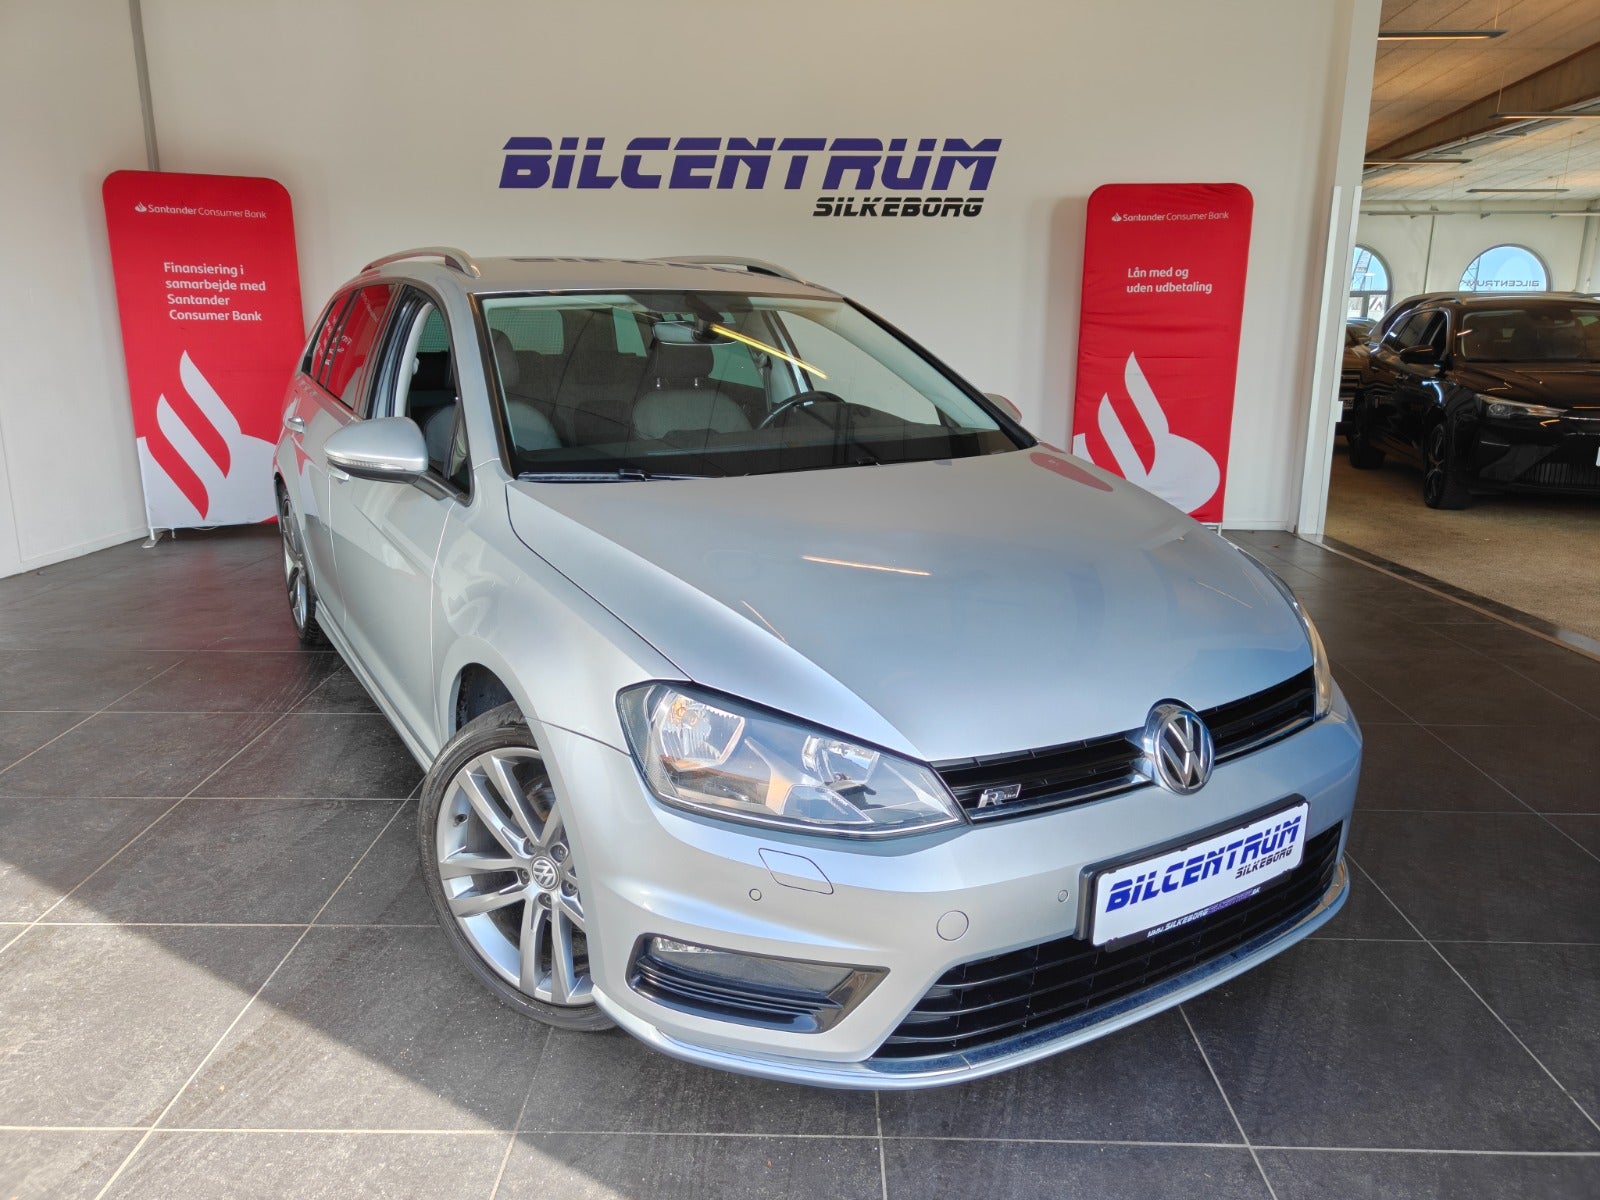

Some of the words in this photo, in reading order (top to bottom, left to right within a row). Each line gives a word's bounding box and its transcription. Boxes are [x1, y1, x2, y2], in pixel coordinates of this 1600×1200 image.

[498, 137, 1003, 190] BILCENTRUM
[147, 204, 196, 216] Santander
[198, 207, 243, 218] Consumer
[245, 209, 267, 219] Bank
[812, 197, 985, 217] SILKEBORG
[1122, 213, 1165, 222] Santander
[1166, 212, 1208, 221] Consumer
[1208, 211, 1229, 220] Bank
[163, 262, 238, 278] Finansiering
[240, 264, 244, 275] i
[1127, 266, 1147, 278] Lån
[1149, 267, 1173, 278] med
[1175, 268, 1189, 279] og
[165, 279, 237, 292] samarbejde
[240, 281, 266, 291] med
[1126, 282, 1153, 293] uden
[1155, 281, 1213, 294] udbetaling
[167, 293, 230, 306] Santander
[169, 309, 229, 321] Consumer
[232, 311, 262, 321] Bank
[1105, 816, 1302, 913] BILCENTRUM
[1235, 845, 1293, 879] SILKEBORG
